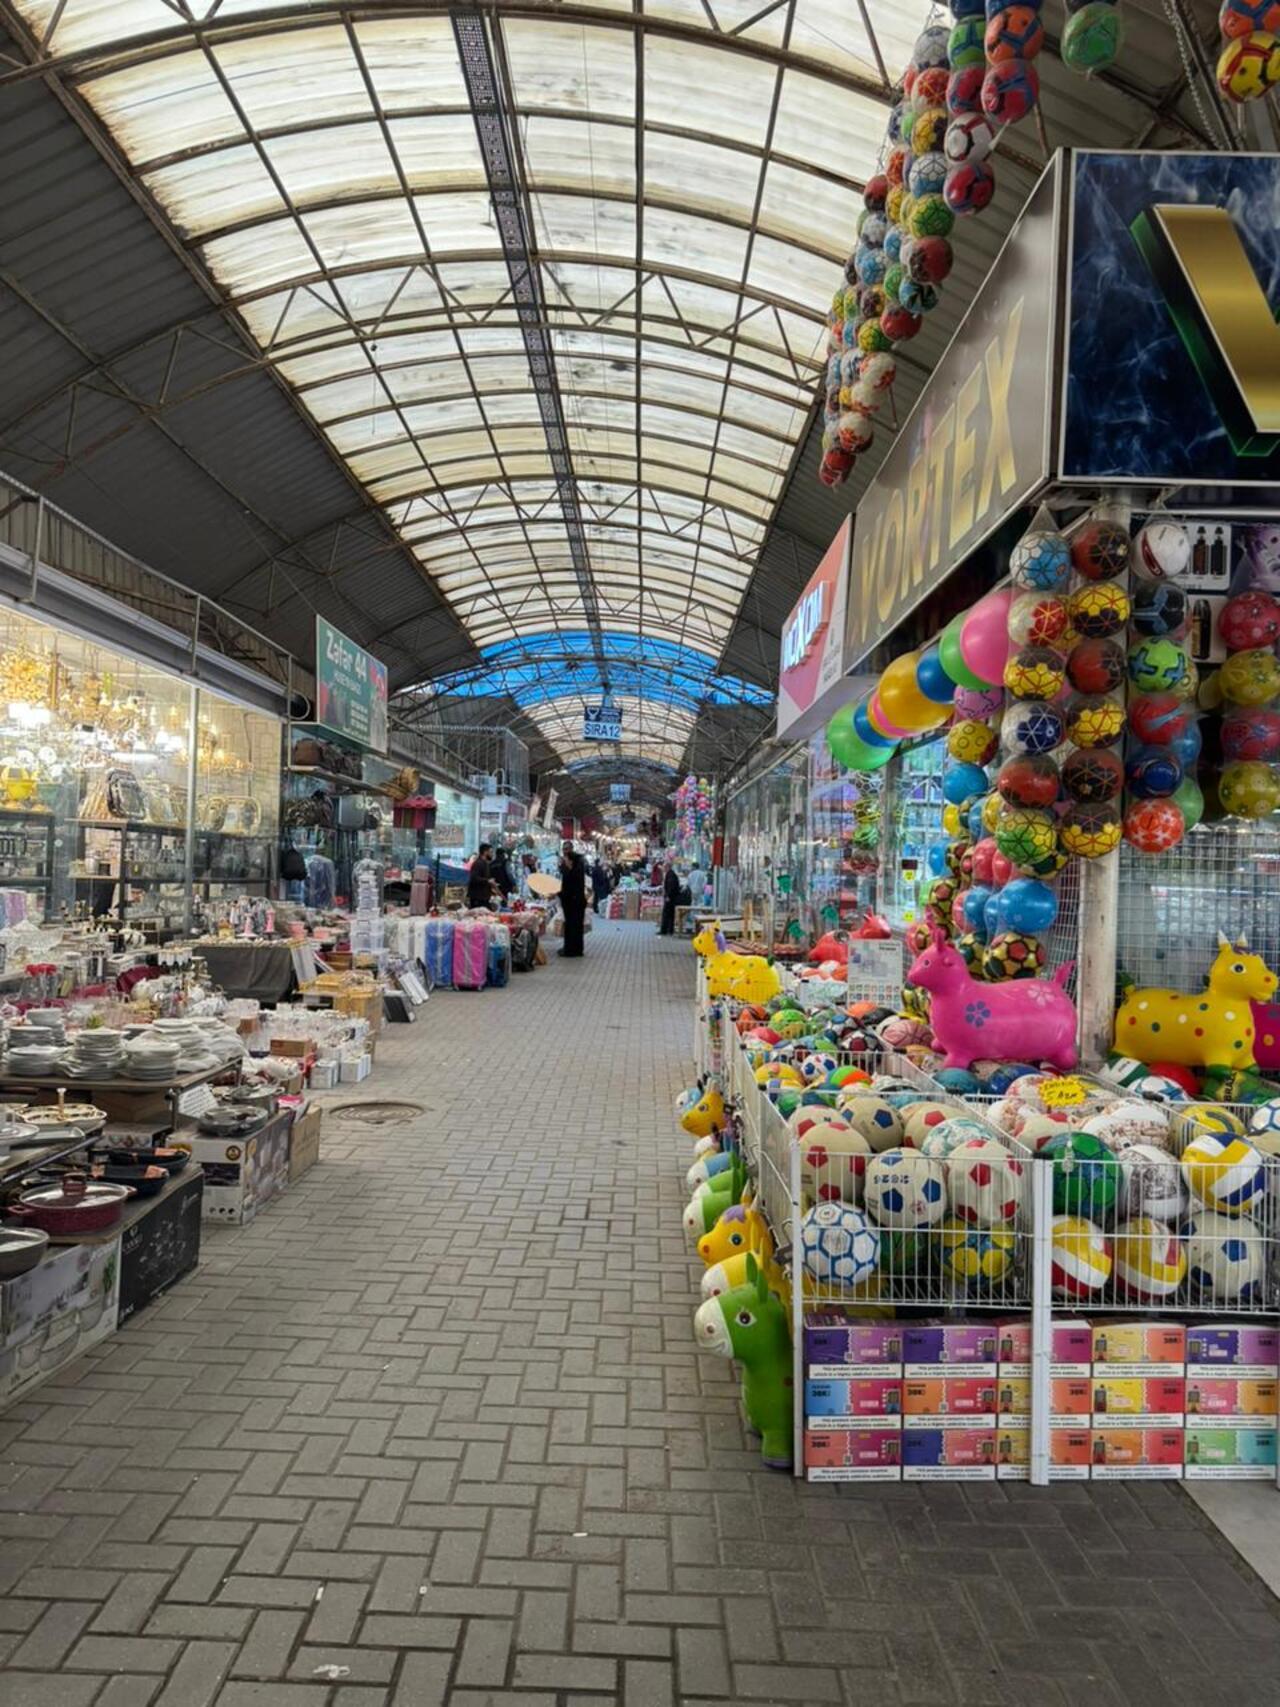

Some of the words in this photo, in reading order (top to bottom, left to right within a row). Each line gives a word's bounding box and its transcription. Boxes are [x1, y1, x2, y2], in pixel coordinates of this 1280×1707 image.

[859, 296, 1025, 644] VORTEX
[584, 723, 608, 736] SIRA
[609, 725, 621, 738] 12
